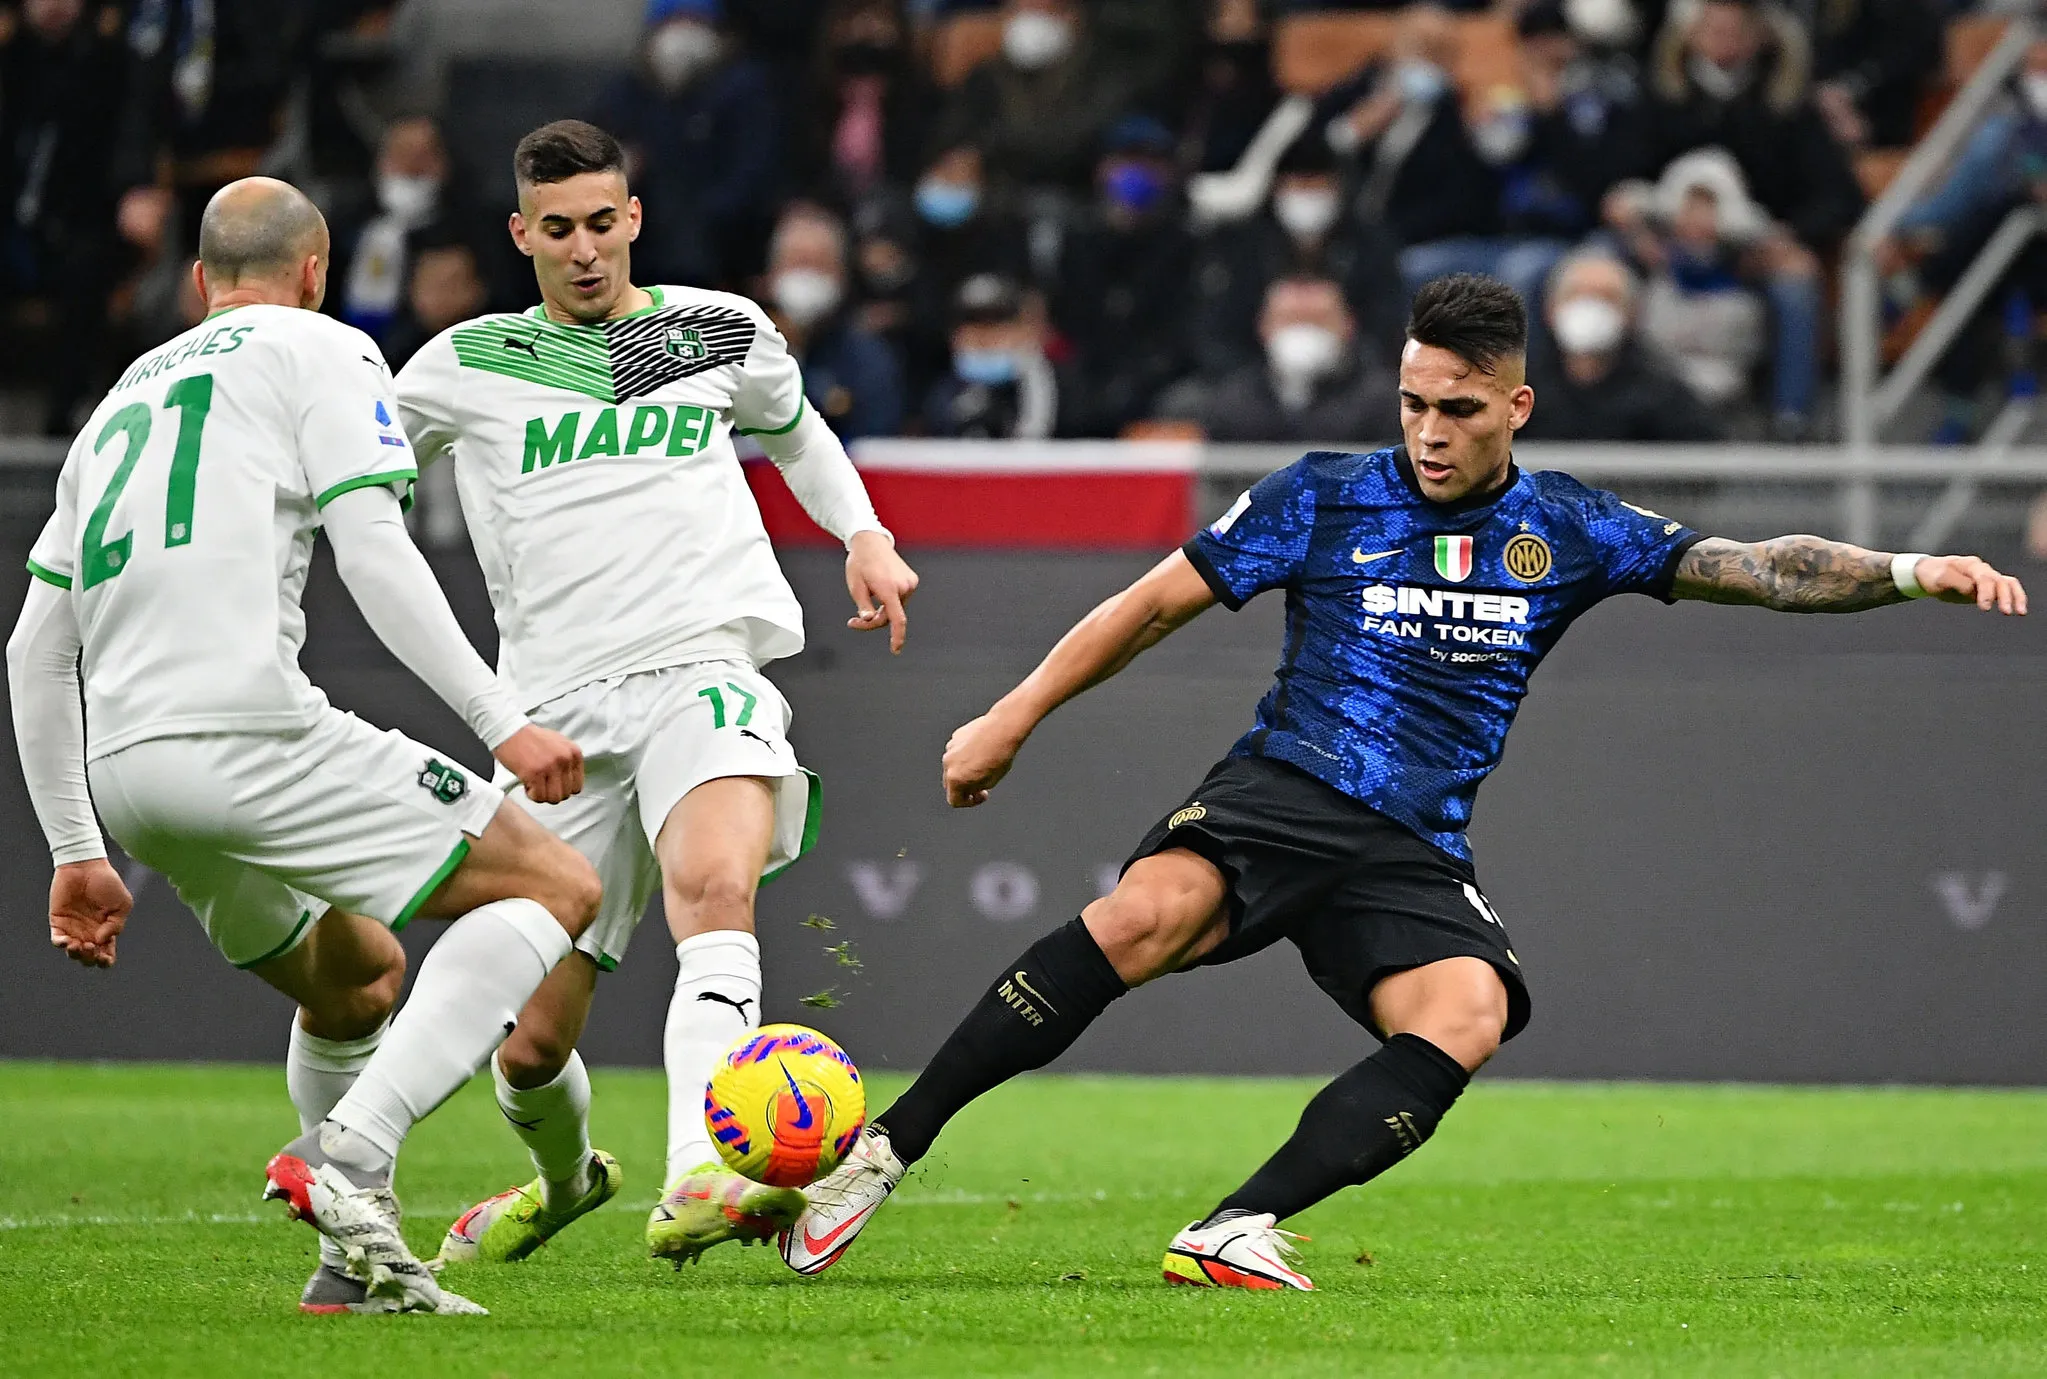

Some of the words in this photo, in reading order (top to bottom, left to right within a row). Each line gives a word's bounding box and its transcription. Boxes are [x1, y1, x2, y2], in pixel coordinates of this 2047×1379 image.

[521, 405, 715, 474] MAPEI
[81, 373, 213, 592] 21
[1361, 583, 1530, 625] $INTER
[1362, 616, 1422, 638] FAN
[1433, 623, 1526, 646] TOKEN
[1430, 647, 1449, 662] by
[697, 681, 757, 729] 17
[997, 979, 1044, 1027] INTER
